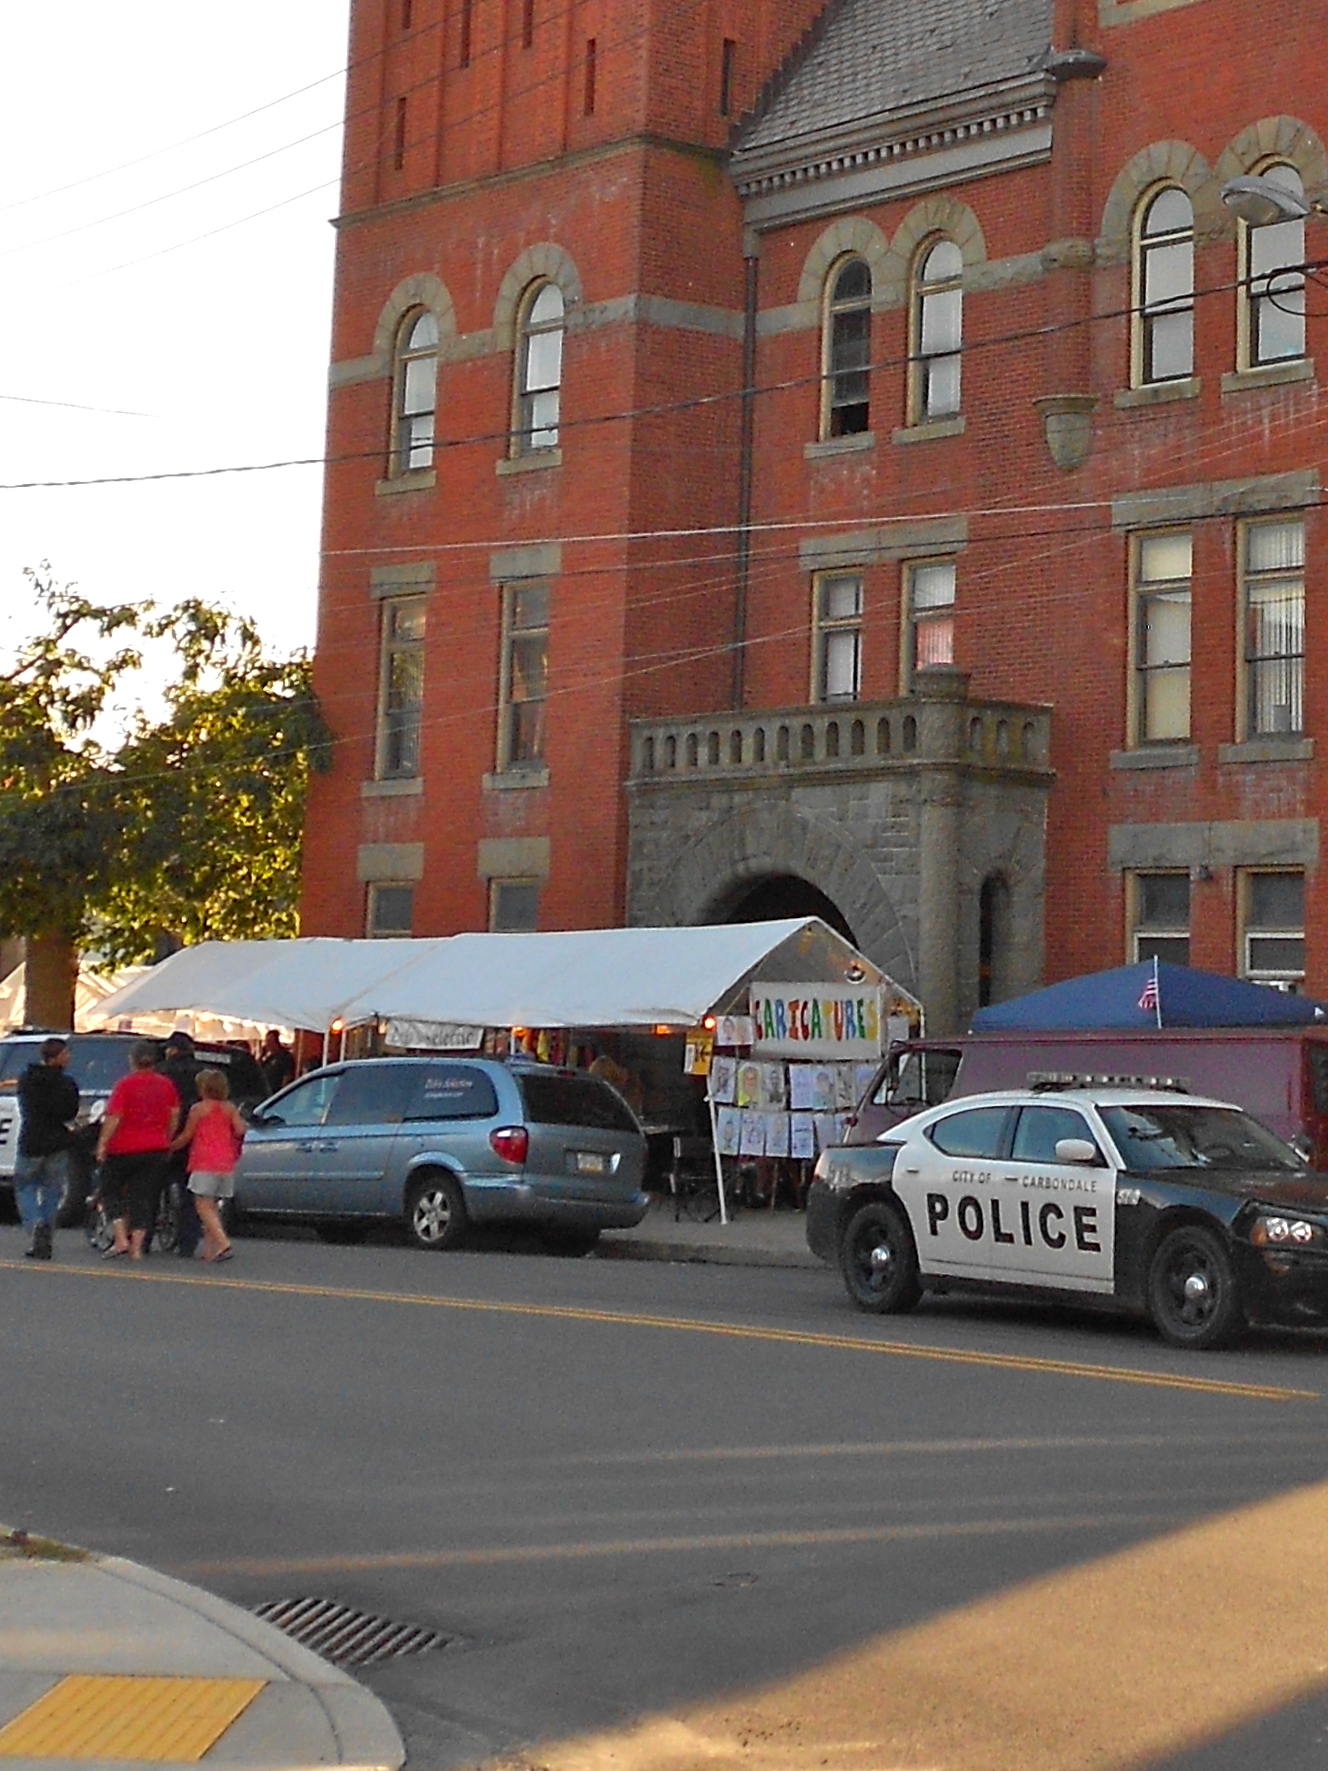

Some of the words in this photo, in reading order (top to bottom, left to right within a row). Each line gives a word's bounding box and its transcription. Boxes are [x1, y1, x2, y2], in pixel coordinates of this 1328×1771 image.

[753, 998, 879, 1042] CARICATURES
[952, 1170, 975, 1184] CITY
[978, 1172, 992, 1184] OF
[1022, 1175, 1098, 1193] CARBONDALE
[926, 1192, 1102, 1253] POLICE
